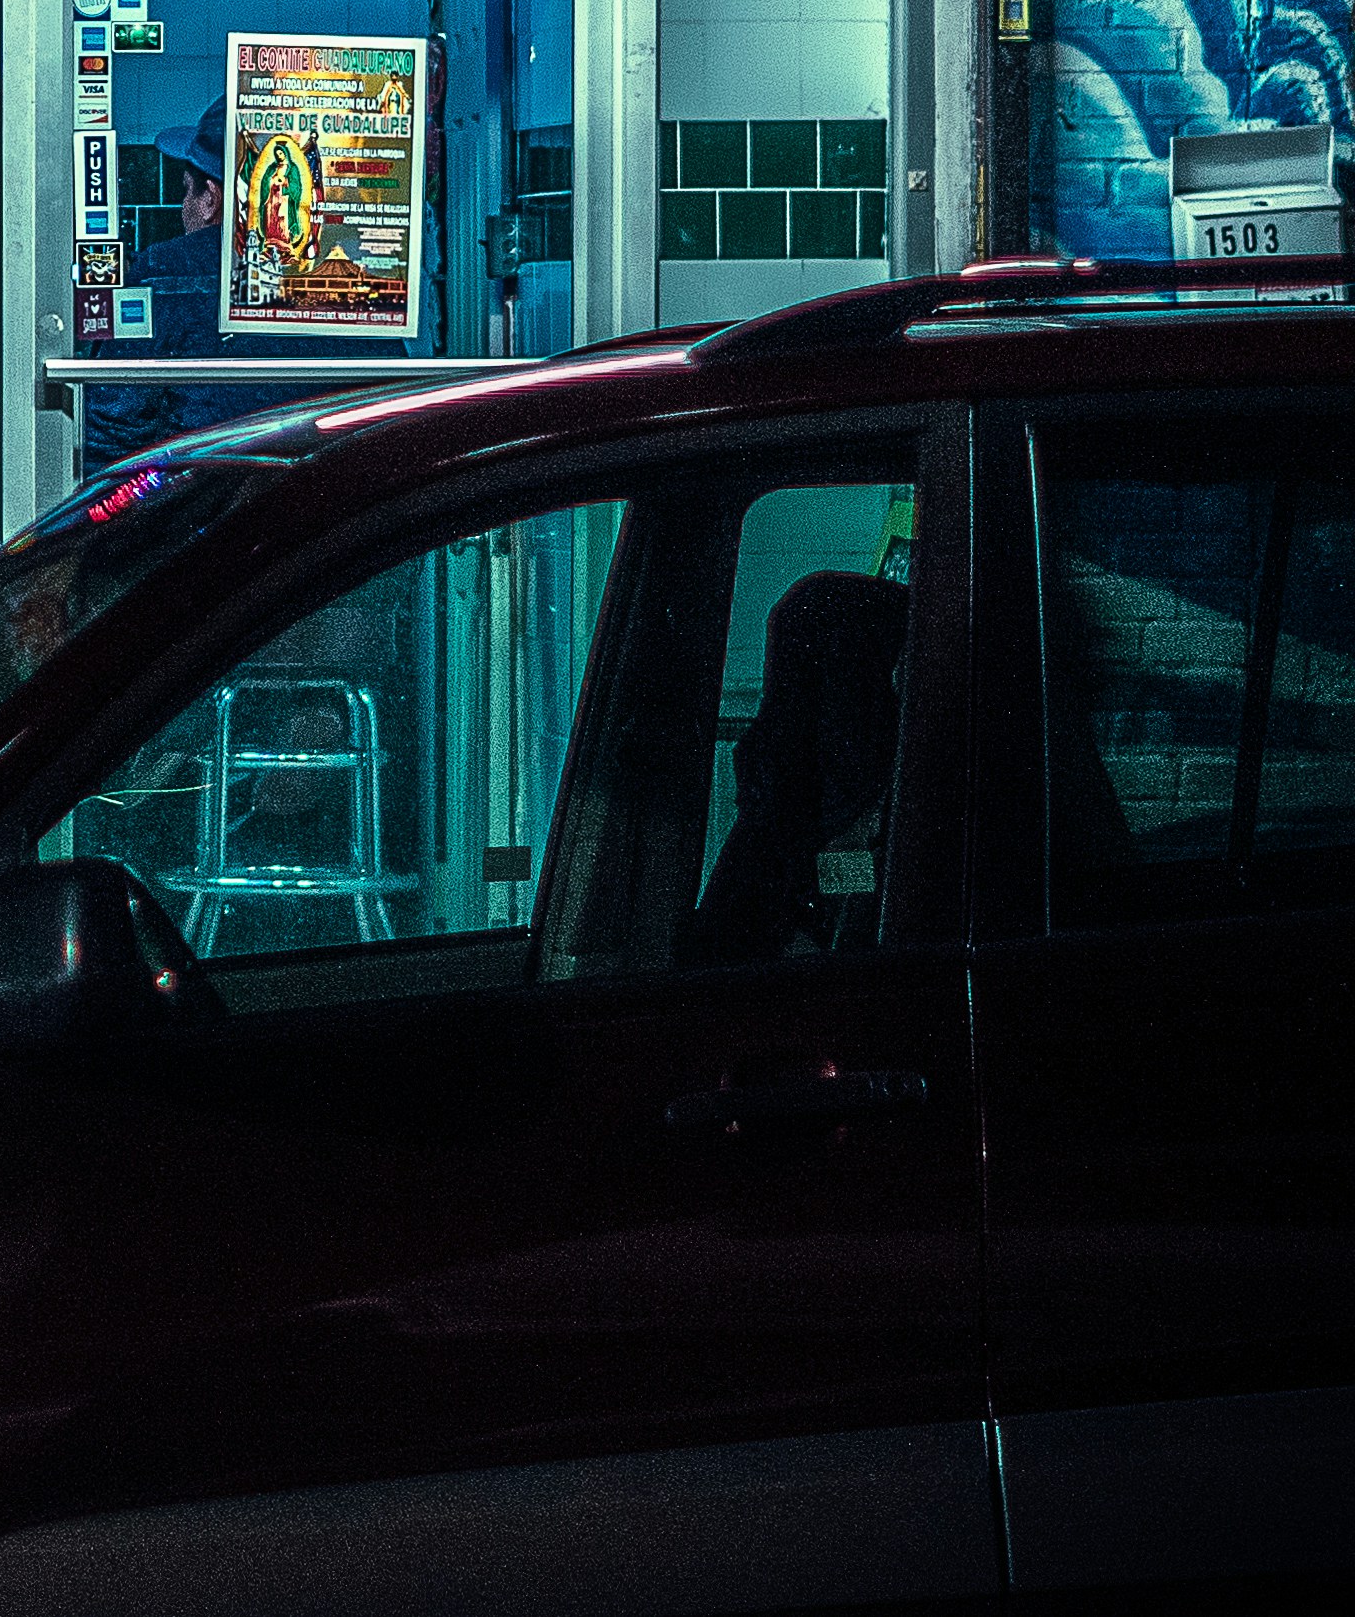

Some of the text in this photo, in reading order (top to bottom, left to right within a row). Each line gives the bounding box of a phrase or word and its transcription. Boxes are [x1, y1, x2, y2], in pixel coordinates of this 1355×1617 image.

[239, 46, 413, 76] EL COMITE GUADALUPANO
[83, 85, 104, 94] VISA
[236, 111, 409, 134] VIRGEN DE GUADALUPE
[90, 141, 102, 202] PUSH
[1203, 221, 1281, 257] 1503
